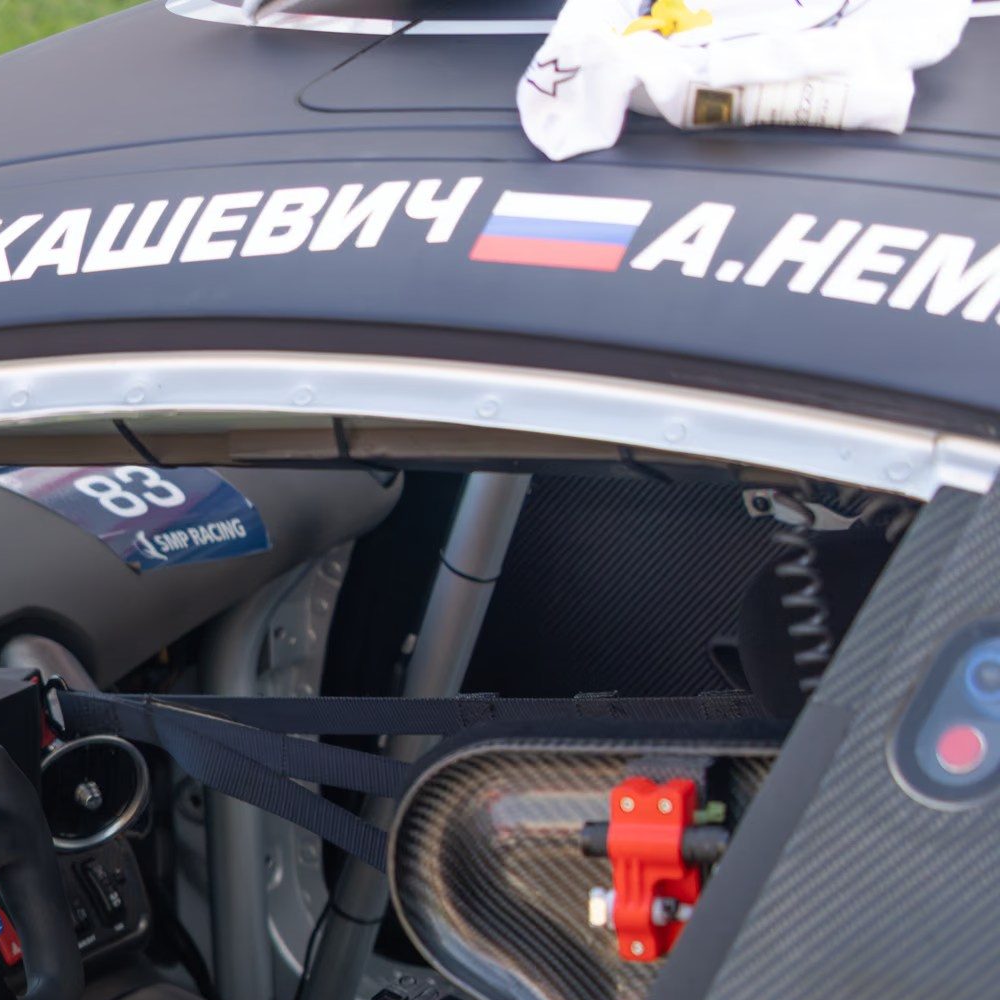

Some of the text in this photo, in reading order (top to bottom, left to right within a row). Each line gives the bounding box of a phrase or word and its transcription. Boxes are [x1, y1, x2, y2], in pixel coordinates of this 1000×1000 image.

[629, 198, 1000, 326] А.НЕМ
[73, 465, 187, 518] 83
[153, 517, 248, 553] SMP RACING
